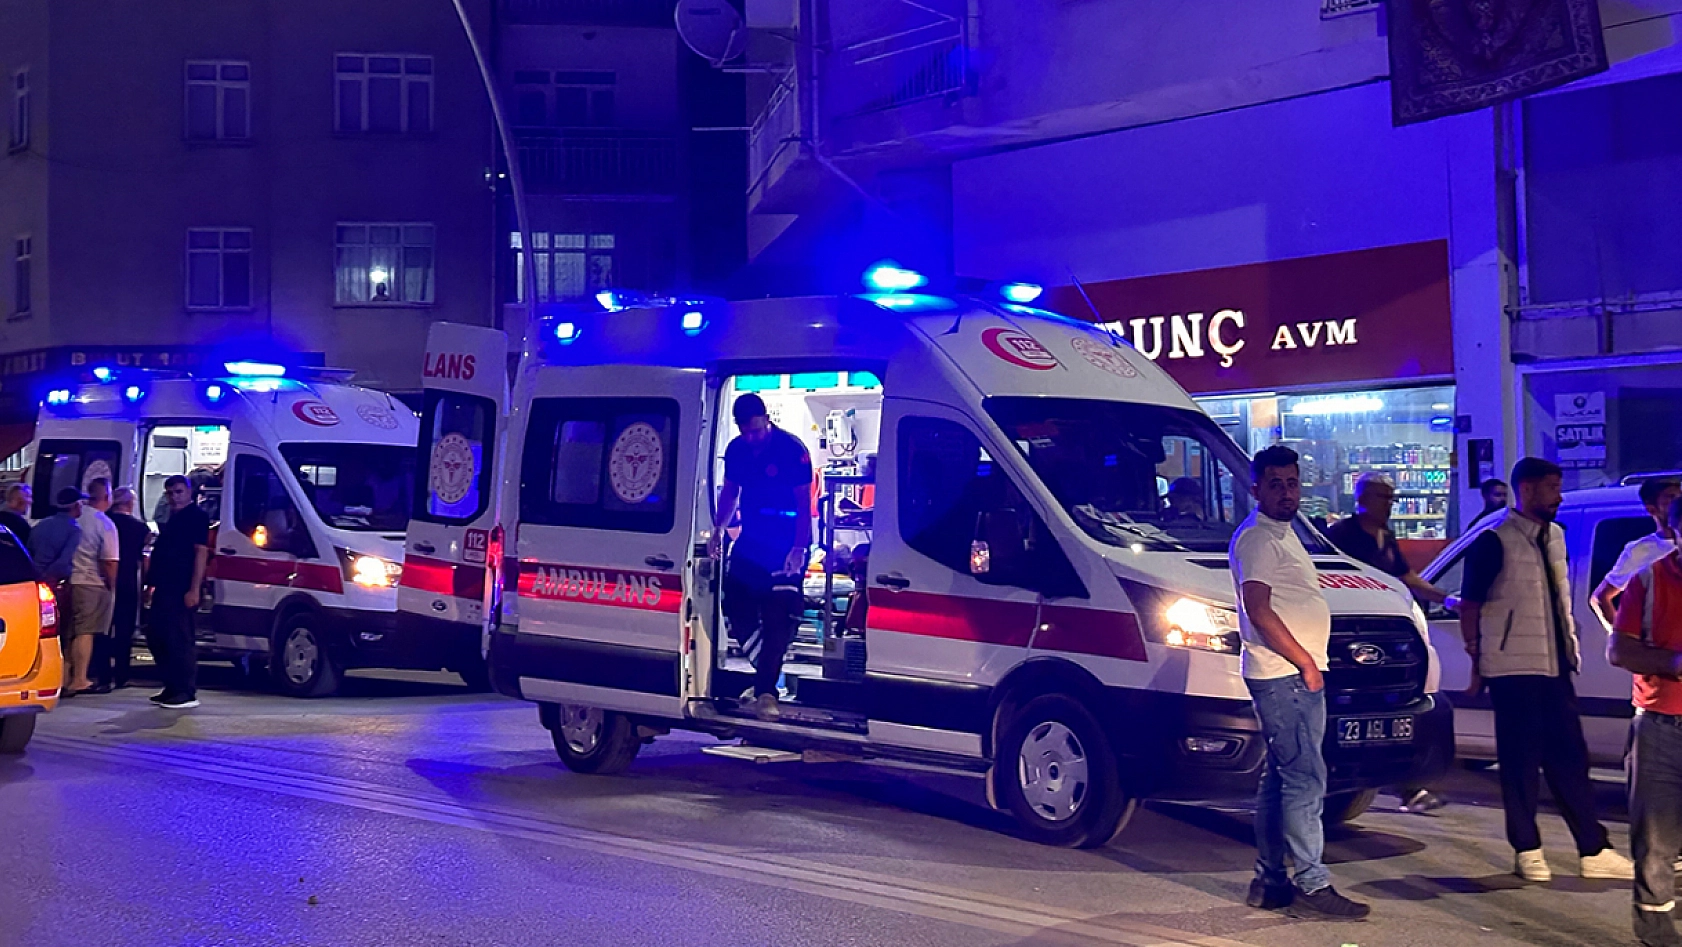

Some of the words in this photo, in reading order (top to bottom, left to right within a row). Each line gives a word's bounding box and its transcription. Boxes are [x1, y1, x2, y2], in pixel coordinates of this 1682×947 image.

[1271, 318, 1358, 349] AVM
[423, 352, 476, 380] LANS
[467, 532, 486, 549] 112
[531, 566, 662, 606] AMBULANS
[1345, 721, 1360, 740] 23
